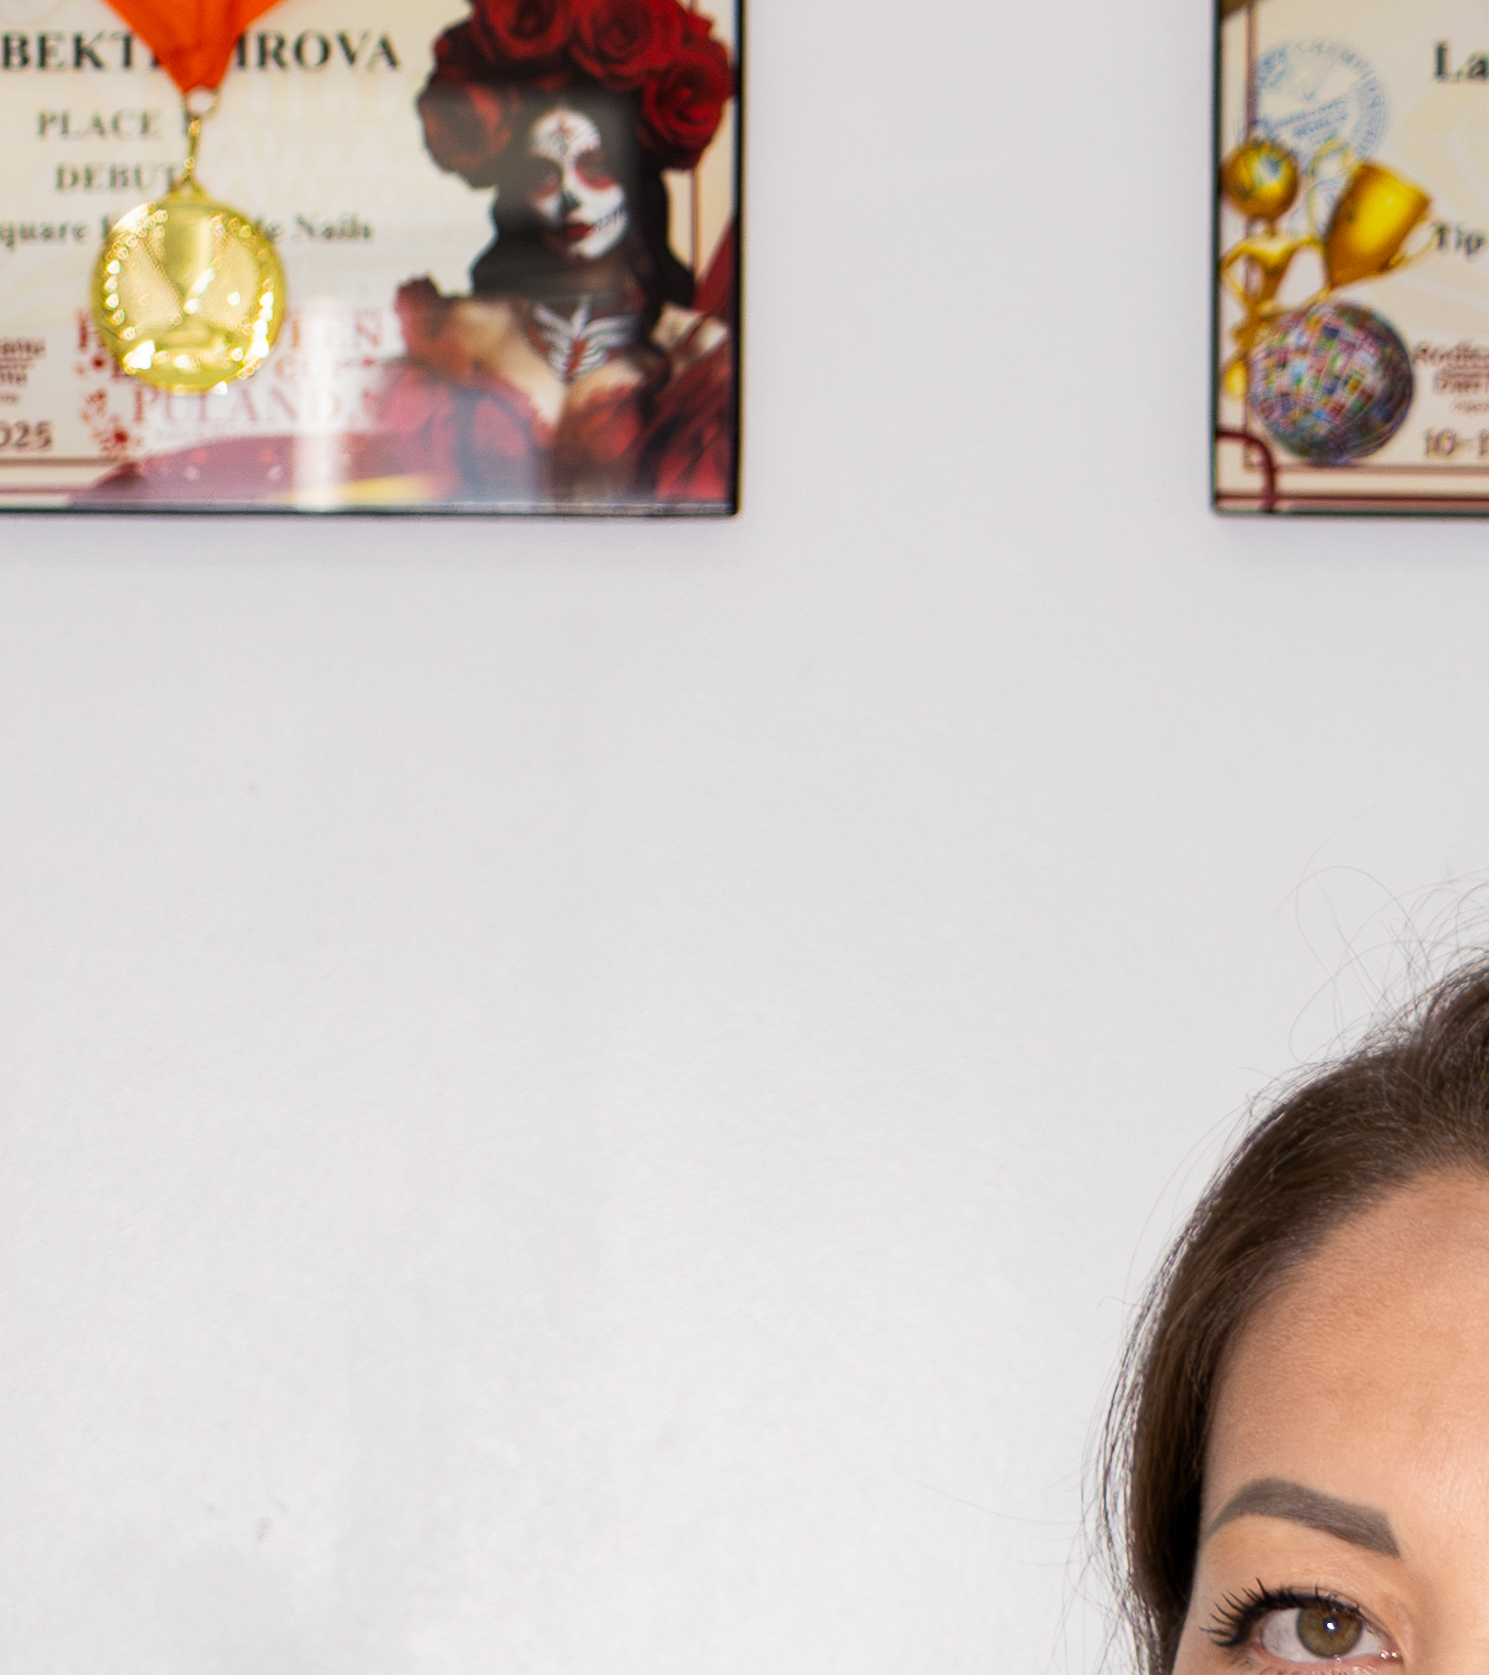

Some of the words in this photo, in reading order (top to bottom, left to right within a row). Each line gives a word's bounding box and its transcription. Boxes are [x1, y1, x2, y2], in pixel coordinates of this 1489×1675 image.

[35, 109, 164, 139] PLACE
[295, 215, 375, 243] Nails
[1433, 223, 1486, 260] Tip
